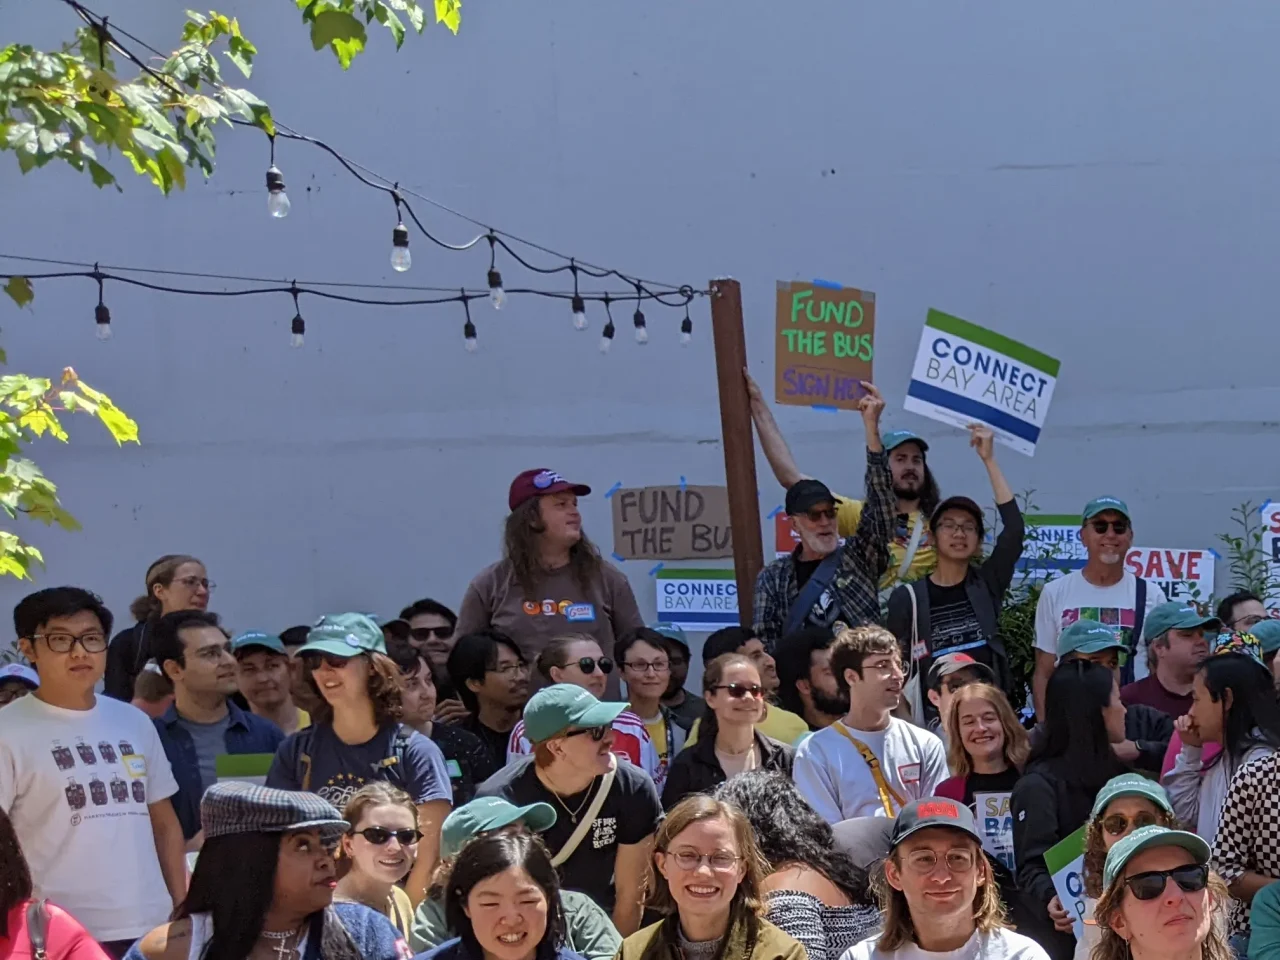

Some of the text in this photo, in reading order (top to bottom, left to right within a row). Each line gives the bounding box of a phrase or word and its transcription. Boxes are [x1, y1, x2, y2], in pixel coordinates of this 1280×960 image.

[790, 290, 864, 328] FUND
[781, 328, 873, 362] THE BUS
[783, 367, 830, 398] SIGN
[931, 337, 1048, 399] CONNECT
[926, 357, 1038, 420] BAY AREA
[620, 490, 704, 524] FUND
[622, 524, 734, 555] THE BU
[1125, 550, 1202, 580] SAVE
[664, 582, 738, 596] CONNEC
[664, 597, 739, 610] BAY ARE
